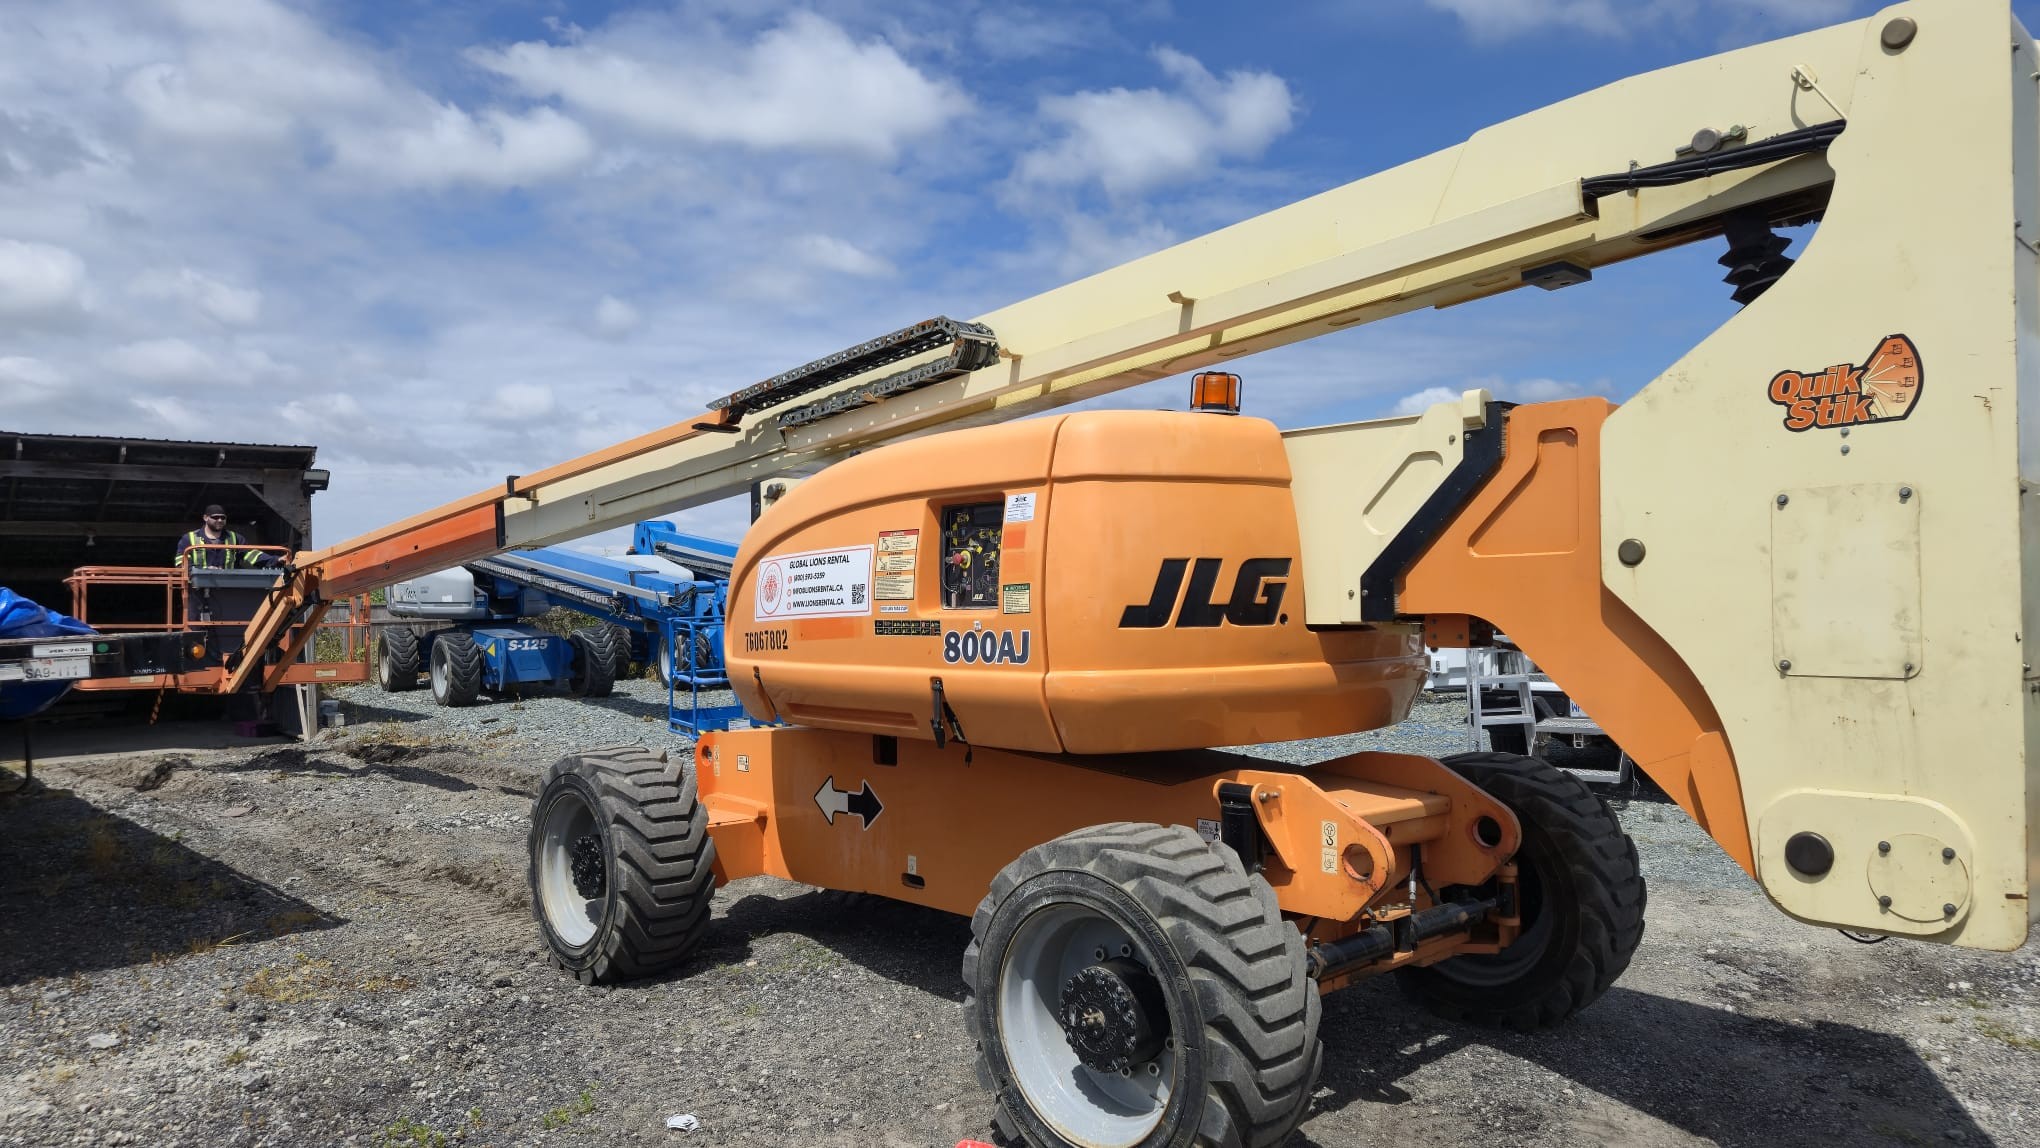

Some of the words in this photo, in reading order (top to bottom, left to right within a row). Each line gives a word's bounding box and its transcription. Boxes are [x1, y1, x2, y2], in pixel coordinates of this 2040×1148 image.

[1770, 363, 1863, 404] Quik
[1786, 393, 1873, 430] Stik
[789, 559, 809, 569] GLOBAL
[809, 556, 827, 567] LIONS
[827, 554, 850, 565] RENTAL
[792, 598, 845, 608] WWW.LIONSRENTAL.CA
[508, 638, 549, 651] S-125
[744, 629, 789, 653] 76067802
[944, 629, 1030, 665] 800AJ
